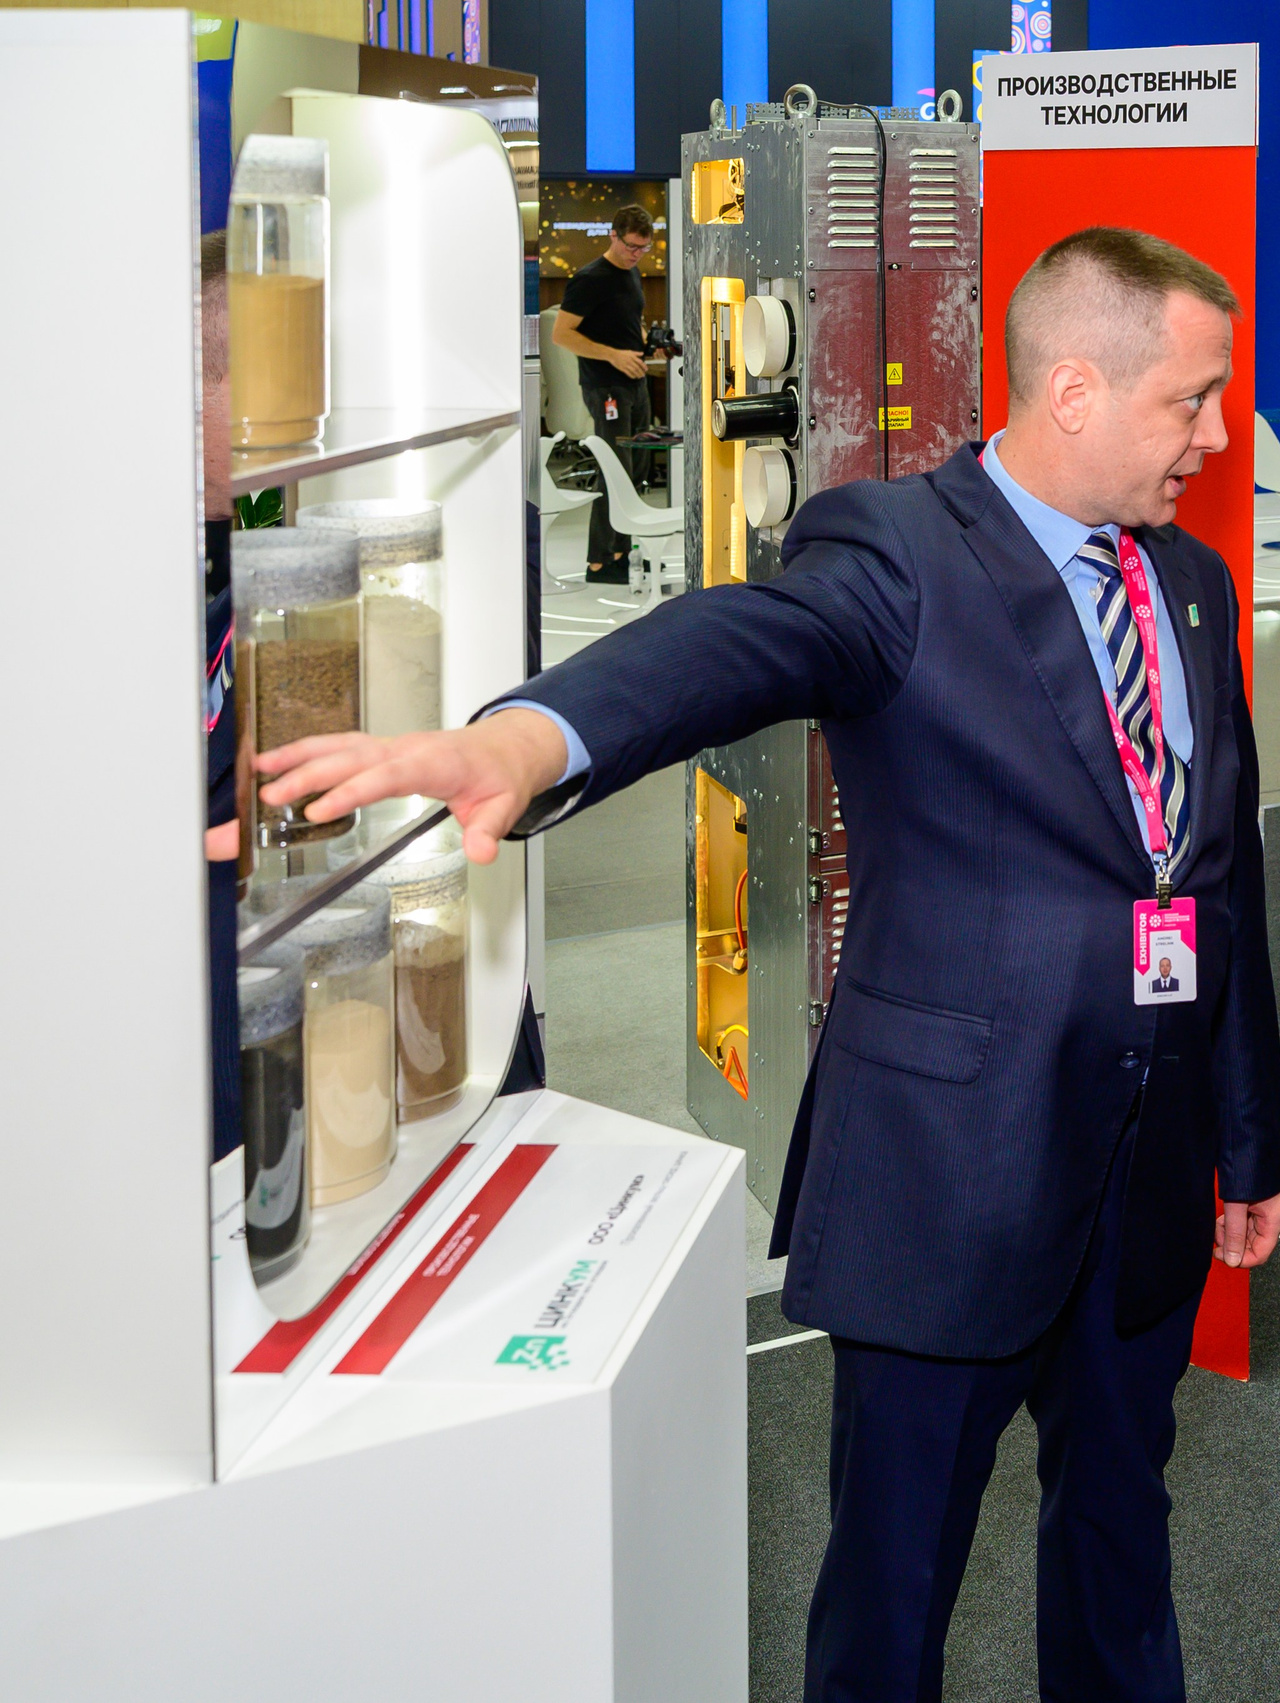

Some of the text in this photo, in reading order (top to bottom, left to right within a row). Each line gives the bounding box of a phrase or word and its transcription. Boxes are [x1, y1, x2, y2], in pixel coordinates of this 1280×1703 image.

[997, 68, 1238, 98] ПРОИЗВОДСТВЕННЫЕ
[1040, 102, 1189, 126] ТЕХНОЛОГИИ
[1139, 912, 1148, 966] EXHIBITOR
[534, 1259, 599, 1329] ЦИНКУМ
